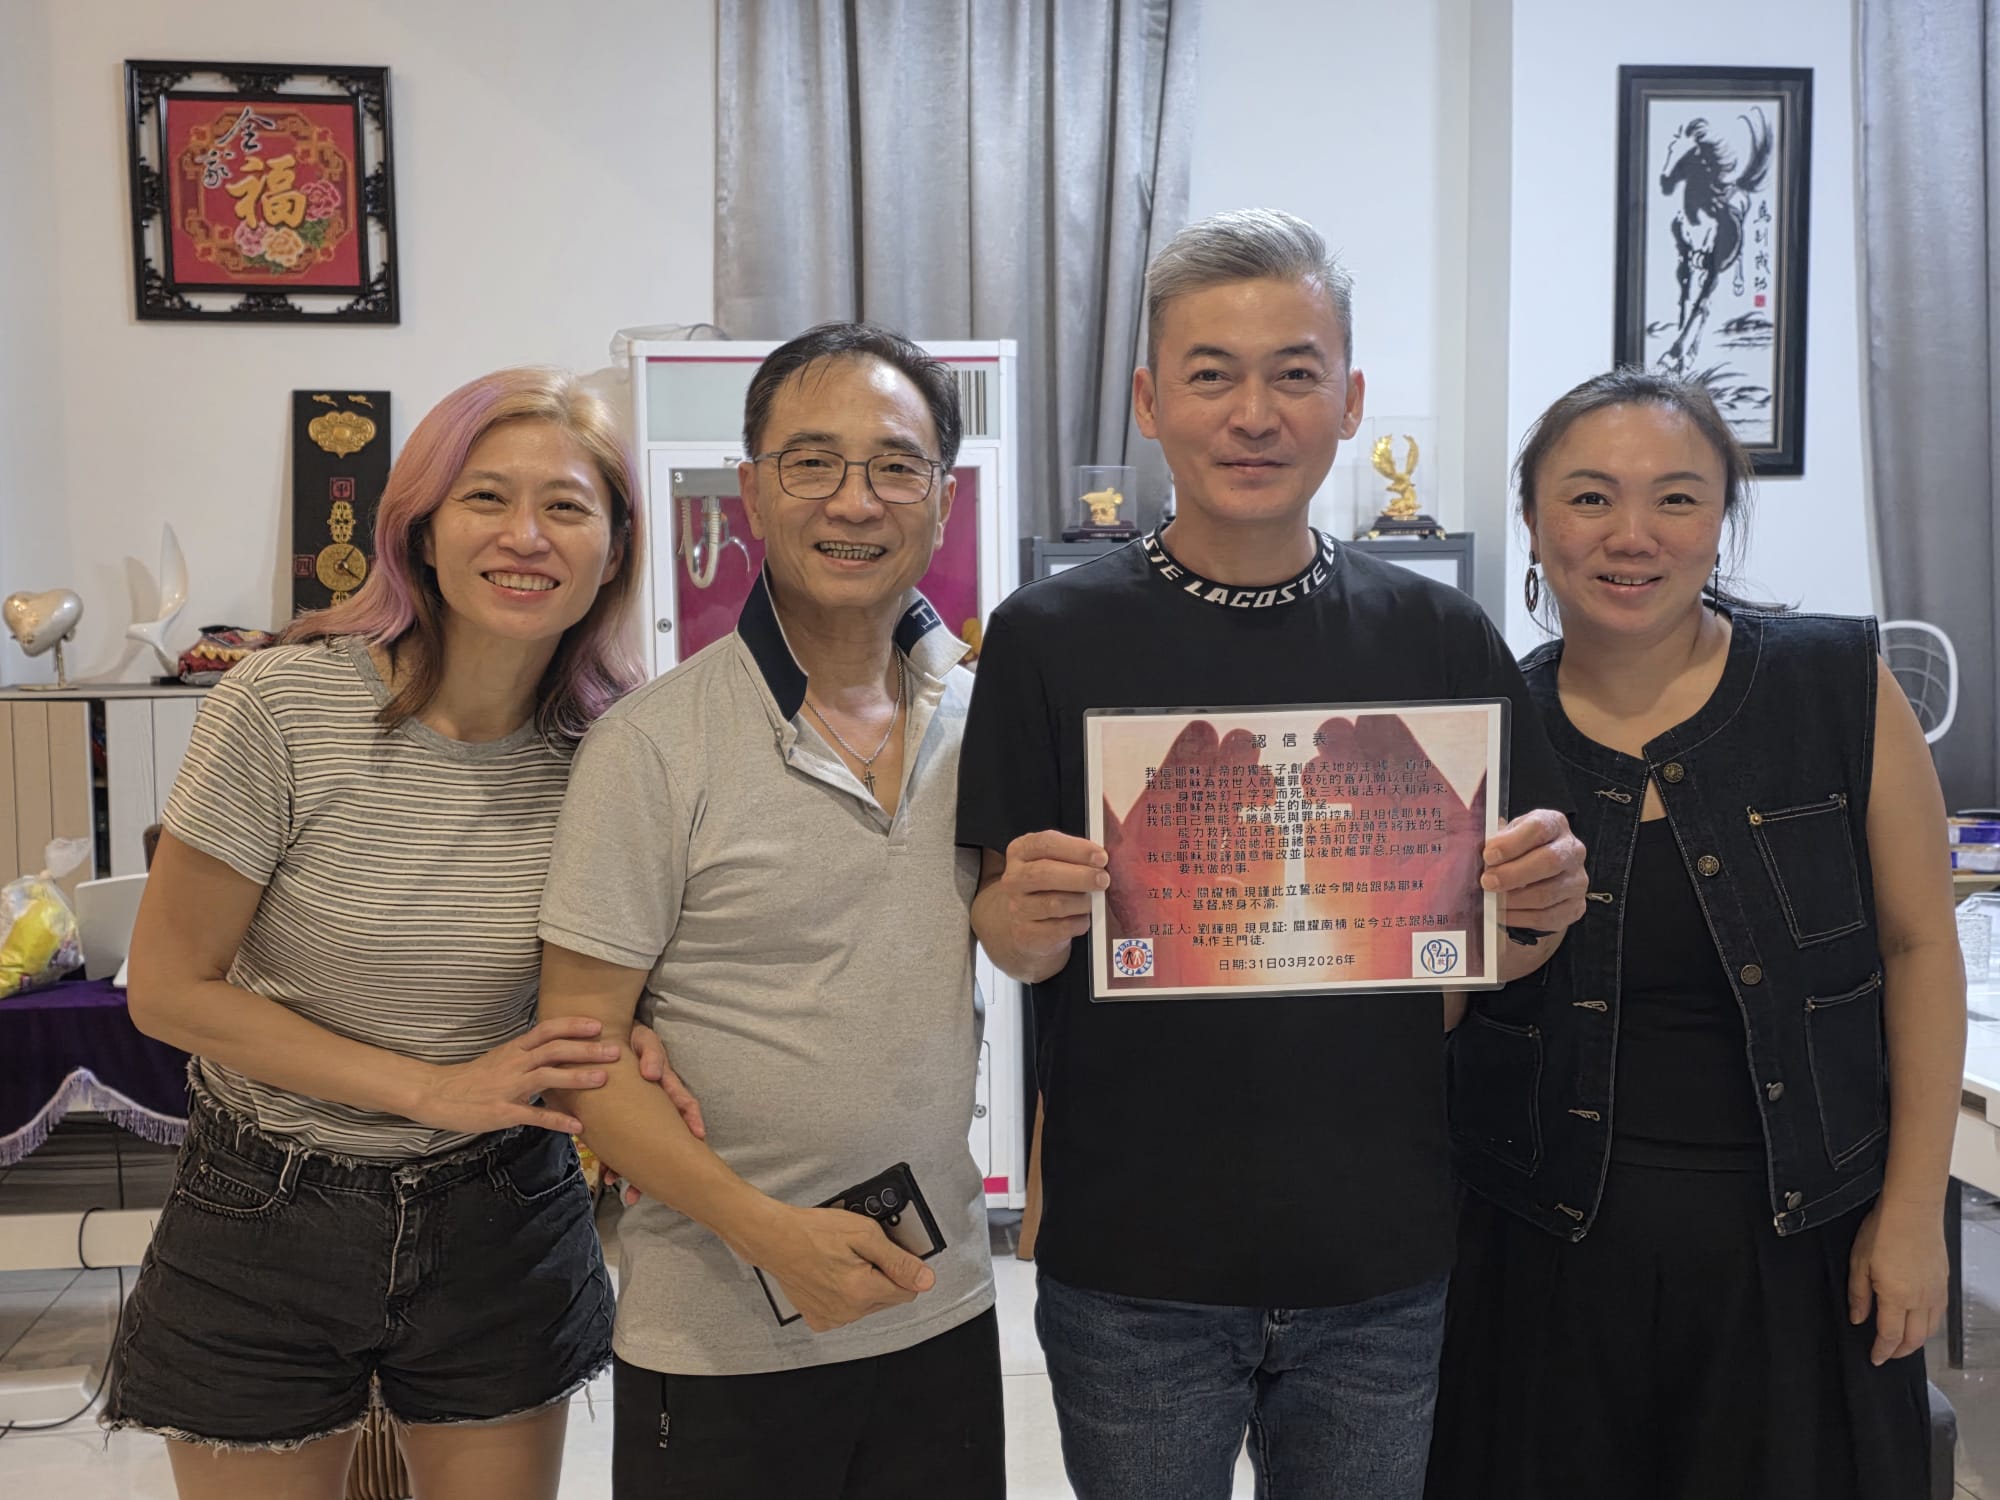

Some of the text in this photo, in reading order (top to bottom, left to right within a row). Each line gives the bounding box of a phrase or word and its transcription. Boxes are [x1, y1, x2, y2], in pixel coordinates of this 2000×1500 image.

[225, 154, 307, 230] 福
[674, 472, 683, 483] 3
[1184, 562, 1326, 608] LACOSTE
[1219, 954, 1356, 971] 日期:31日03月2026年
